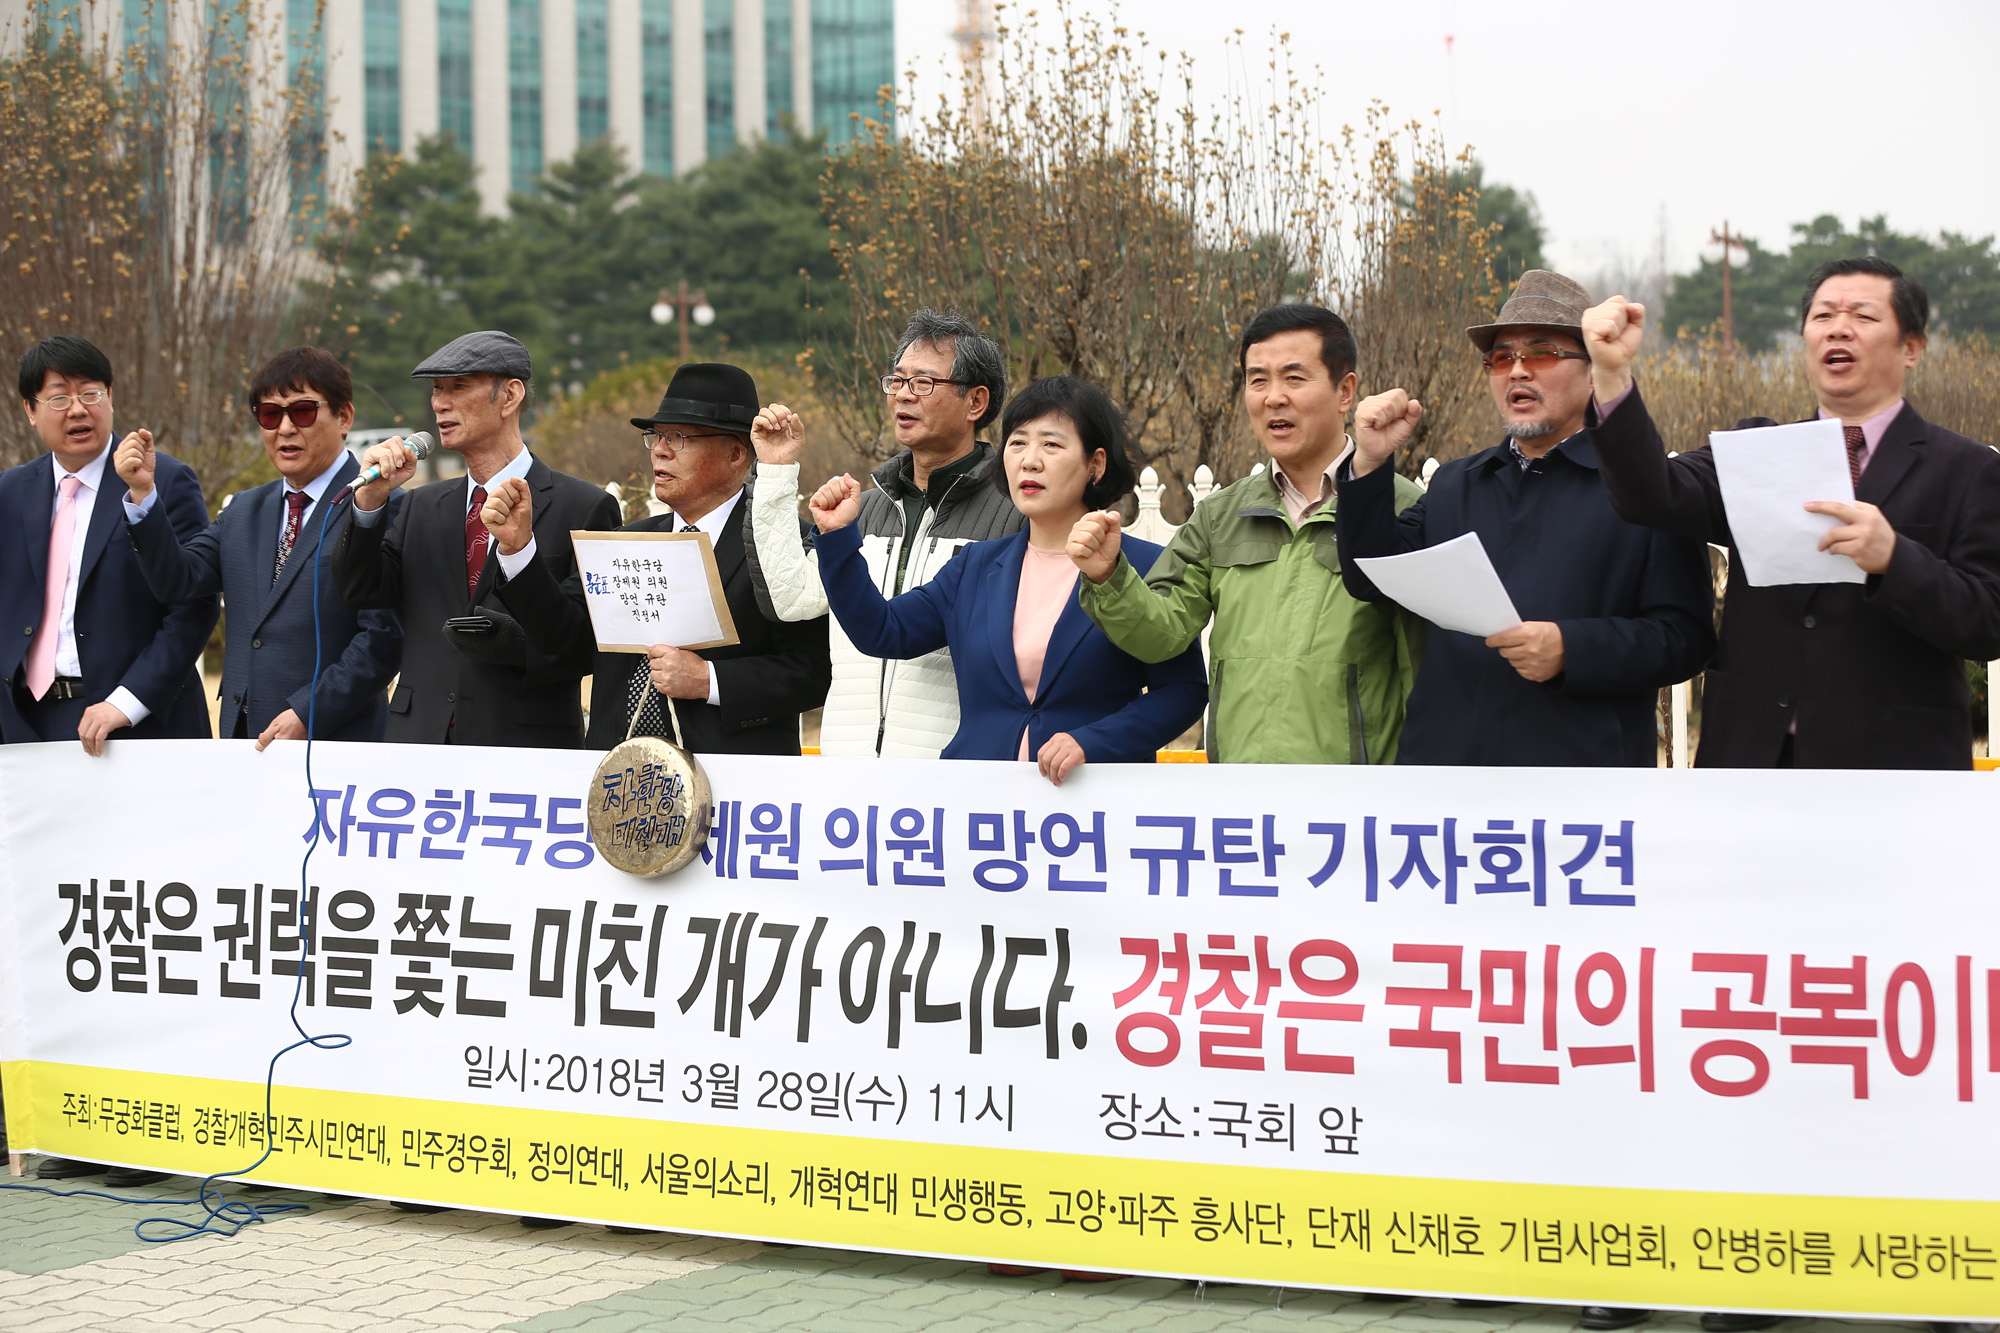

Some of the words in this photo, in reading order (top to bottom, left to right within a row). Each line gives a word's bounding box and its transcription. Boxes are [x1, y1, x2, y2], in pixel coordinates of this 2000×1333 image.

[612, 558, 663, 573] 자유한국당
[612, 575, 641, 590] 장제원
[647, 575, 668, 590] 의원
[619, 592, 639, 606] 망언
[644, 592, 667, 606] 규탄
[631, 609, 661, 623] 진정서
[602, 763, 685, 816] 자한당
[302, 783, 594, 869] 자유한국당
[699, 800, 802, 880] 제원
[820, 806, 945, 887] 의원
[969, 810, 1107, 892] 망언
[1130, 815, 1285, 897] 규탄
[1307, 816, 1635, 906] 기자회견
[612, 815, 686, 853] 미친개
[58, 879, 202, 995] 경찰은
[213, 884, 379, 1010] 권력을
[391, 893, 514, 1018] 쫓는
[529, 900, 668, 1028] 미친
[677, 912, 828, 1043] 개가
[839, 921, 1087, 1059] 아니다.
[1113, 933, 1365, 1075] 경찰은
[1385, 944, 1656, 1092] 국민의
[463, 1046, 665, 1104] 일시:2018년
[682, 1063, 739, 1109] 3월
[757, 1071, 907, 1125] 28일(수)
[930, 1084, 1013, 1131] 11시
[1099, 1093, 1294, 1151] 장소:국회
[1319, 1107, 1363, 1155] 앞
[63, 1093, 184, 1142] 주최:무궁화클럽,
[193, 1106, 391, 1166] 경찰개혁민주시민연대,
[403, 1129, 516, 1179] 민주경우회,
[528, 1142, 628, 1191] 정의연대,
[641, 1153, 775, 1205] 서울의소리,
[790, 1166, 897, 1215] 개혁연대
[913, 1176, 1032, 1228] 민생행동,
[1191, 1197, 1292, 1248] 흥사단,
[1309, 1206, 1370, 1252] 단재
[1385, 1212, 1484, 1257] 신채호
[1500, 1218, 1675, 1270] 기념사업회,
[1693, 1227, 1835, 1275] 안병하를
[1851, 1233, 1996, 1280] 사랑하는
